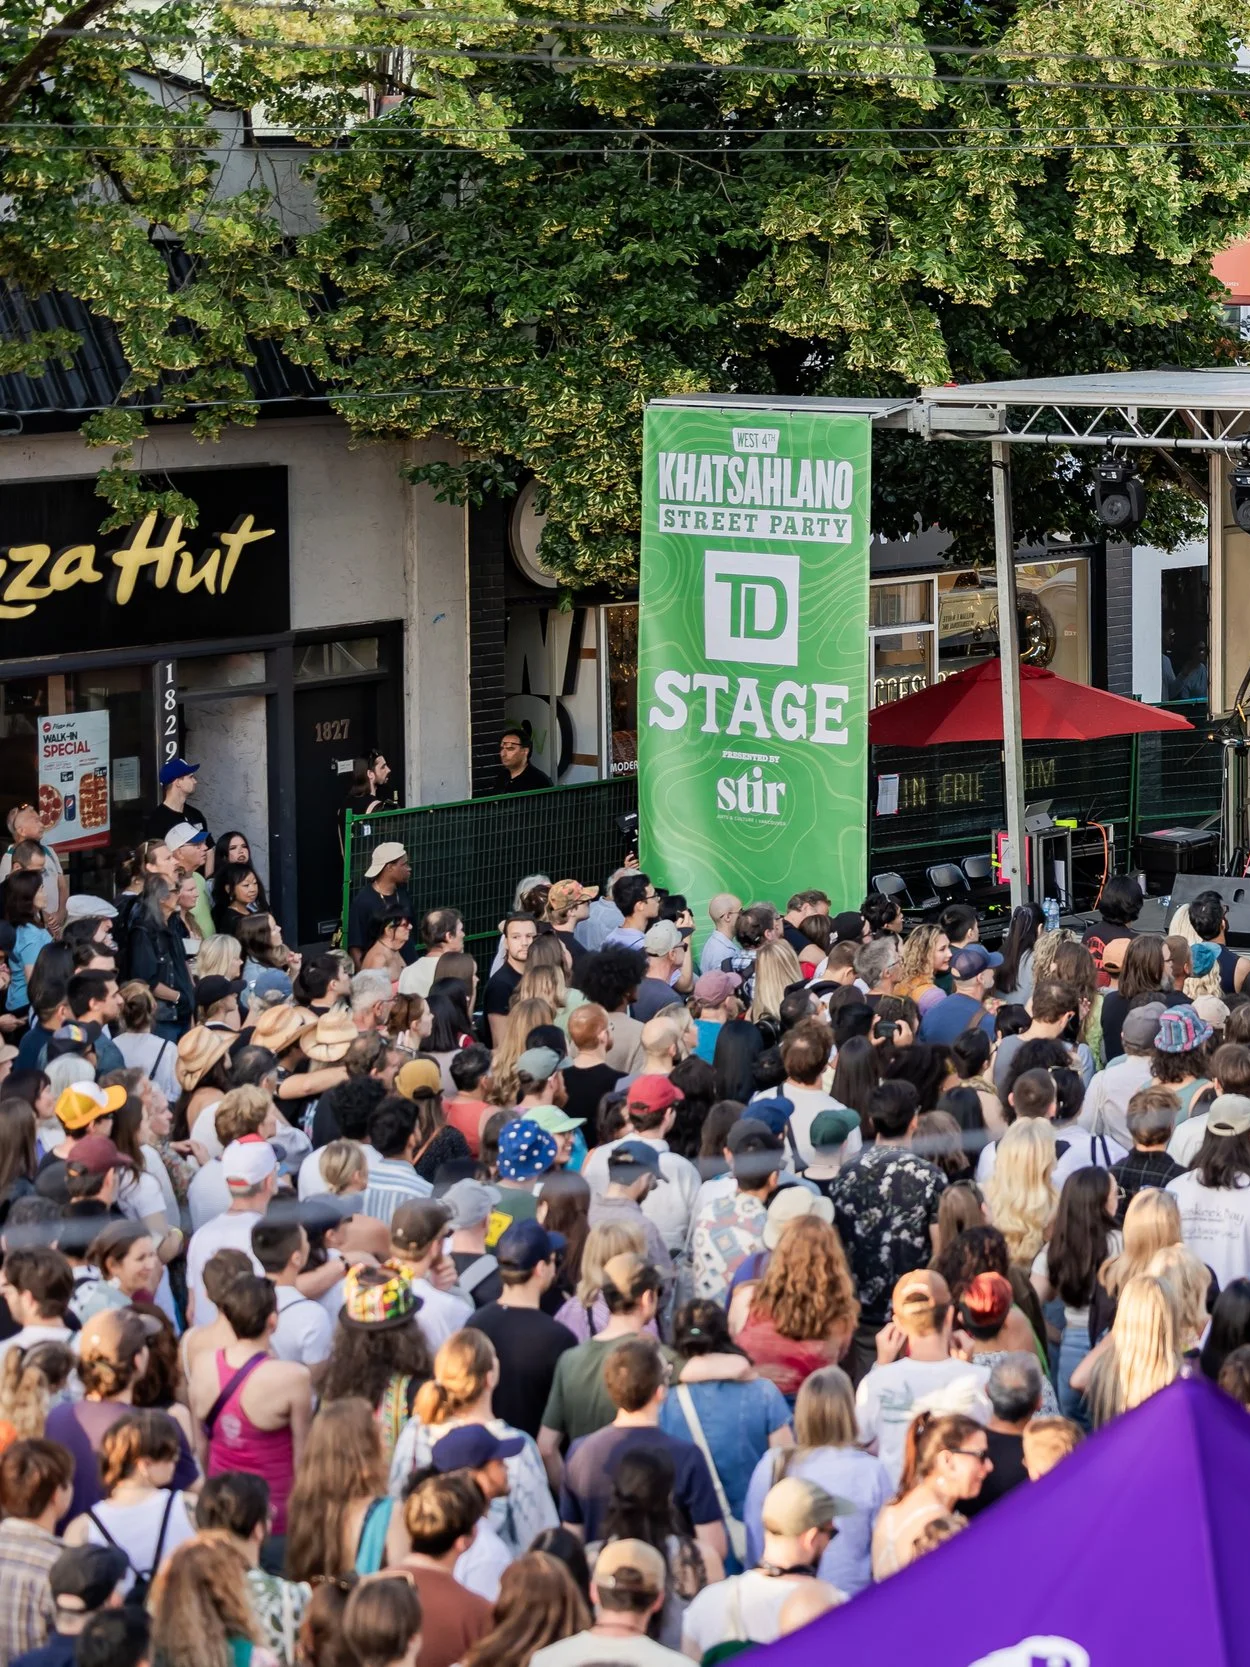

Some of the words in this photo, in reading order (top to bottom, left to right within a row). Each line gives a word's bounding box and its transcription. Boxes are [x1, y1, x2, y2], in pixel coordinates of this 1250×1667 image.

[737, 432, 759, 448] WEST
[762, 434, 776, 448] 4TH
[658, 452, 854, 510] KHATSAHLANO
[664, 509, 758, 532] STREET
[769, 515, 848, 538] PARTY
[112, 511, 275, 605] Hut
[715, 572, 788, 641] TD
[164, 663, 178, 764] 1829
[649, 670, 849, 745] STAGE
[43, 731, 78, 743] WALK-IN
[43, 740, 90, 758] SPECIAL
[315, 719, 350, 742] 1827
[722, 751, 768, 762] PRESENTED
[769, 755, 780, 764] BY
[717, 766, 786, 815] stir
